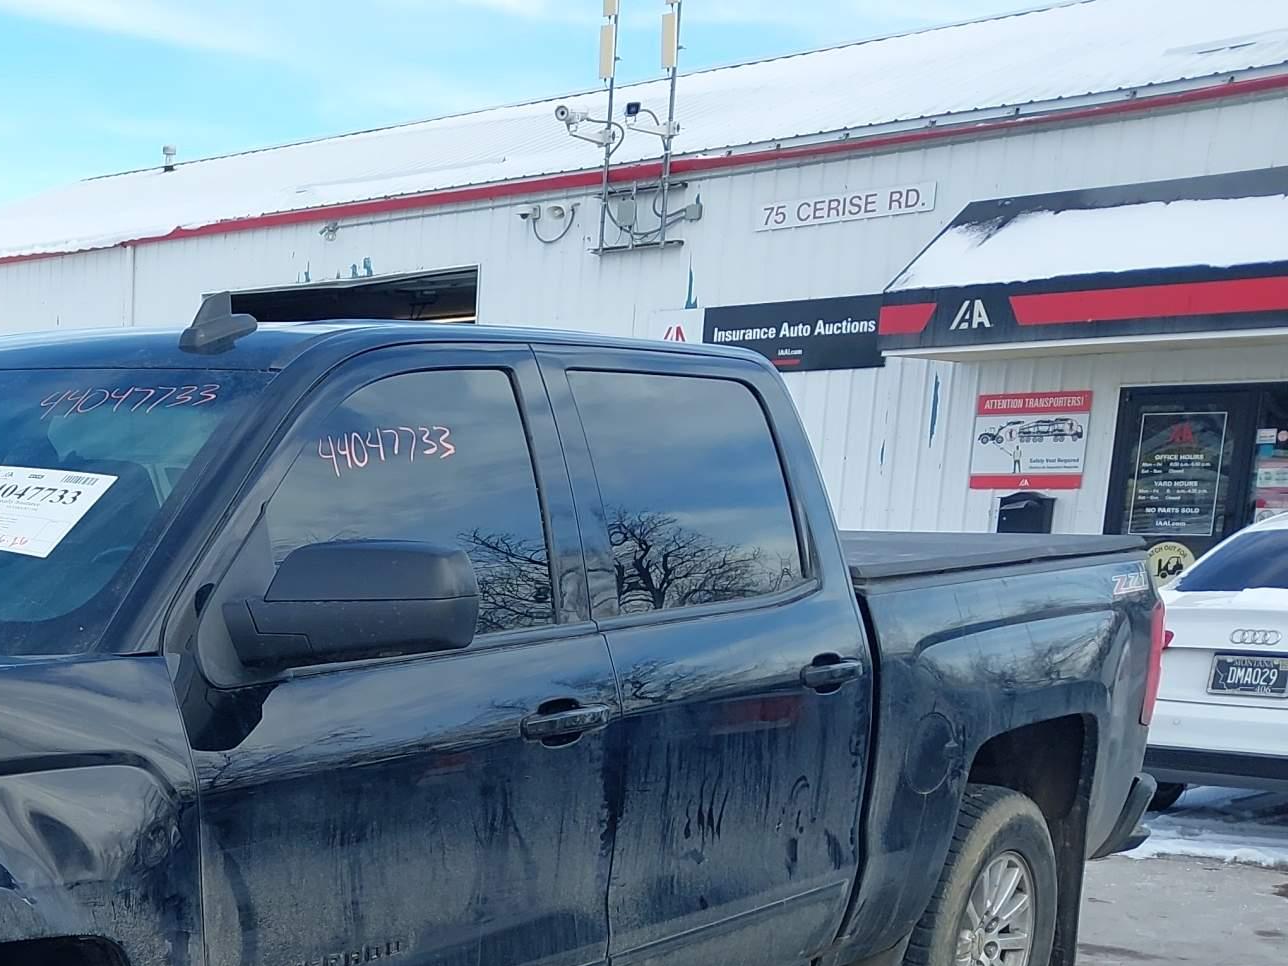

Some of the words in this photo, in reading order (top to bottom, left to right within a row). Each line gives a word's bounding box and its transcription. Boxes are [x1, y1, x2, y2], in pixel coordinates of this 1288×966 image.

[763, 205, 786, 226] 75
[796, 193, 878, 220] CERISE
[888, 188, 926, 211] RD.
[713, 323, 776, 343] Insurance
[779, 322, 811, 339] Auto
[814, 317, 877, 336] Auctions
[40, 383, 221, 419] 44047733
[984, 398, 1023, 410] ATTENTION
[1025, 396, 1085, 408] TRANSPORTERS!
[318, 426, 456, 478] 44047733
[1226, 666, 1278, 686] DMA029
